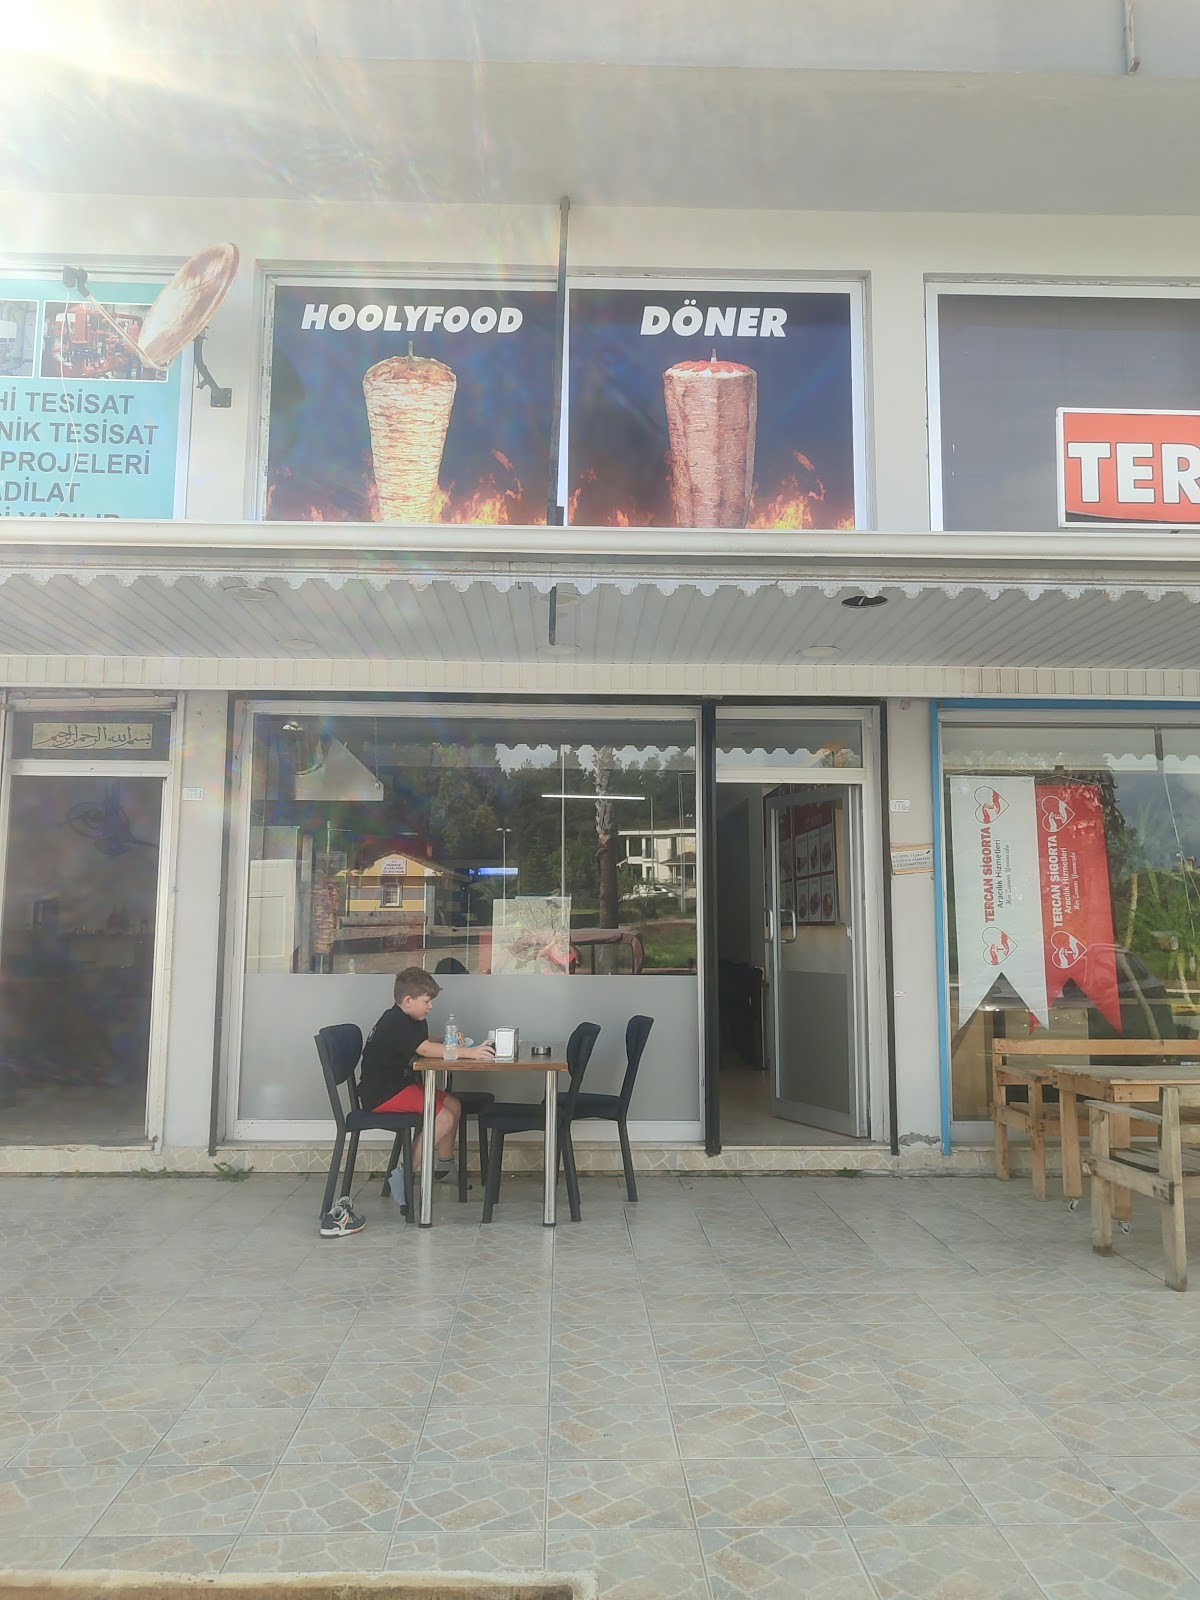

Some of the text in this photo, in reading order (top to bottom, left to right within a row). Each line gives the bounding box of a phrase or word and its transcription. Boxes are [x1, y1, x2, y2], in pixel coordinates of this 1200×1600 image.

[301, 303, 524, 334] HOOLYFOOD
[640, 299, 788, 338] DÖNER
[25, 388, 135, 415] TESİSAT
[50, 418, 159, 445] TESİSAT
[1, 449, 150, 475] PROJELERİ
[1067, 441, 1200, 504] TER
[0, 476, 81, 503] DİLAT
[980, 826, 995, 923] TERCAN SİGORTA
[993, 839, 1004, 908] Aracılık Hizmetleri
[1047, 835, 1063, 928] TERCAN SİGORTA
